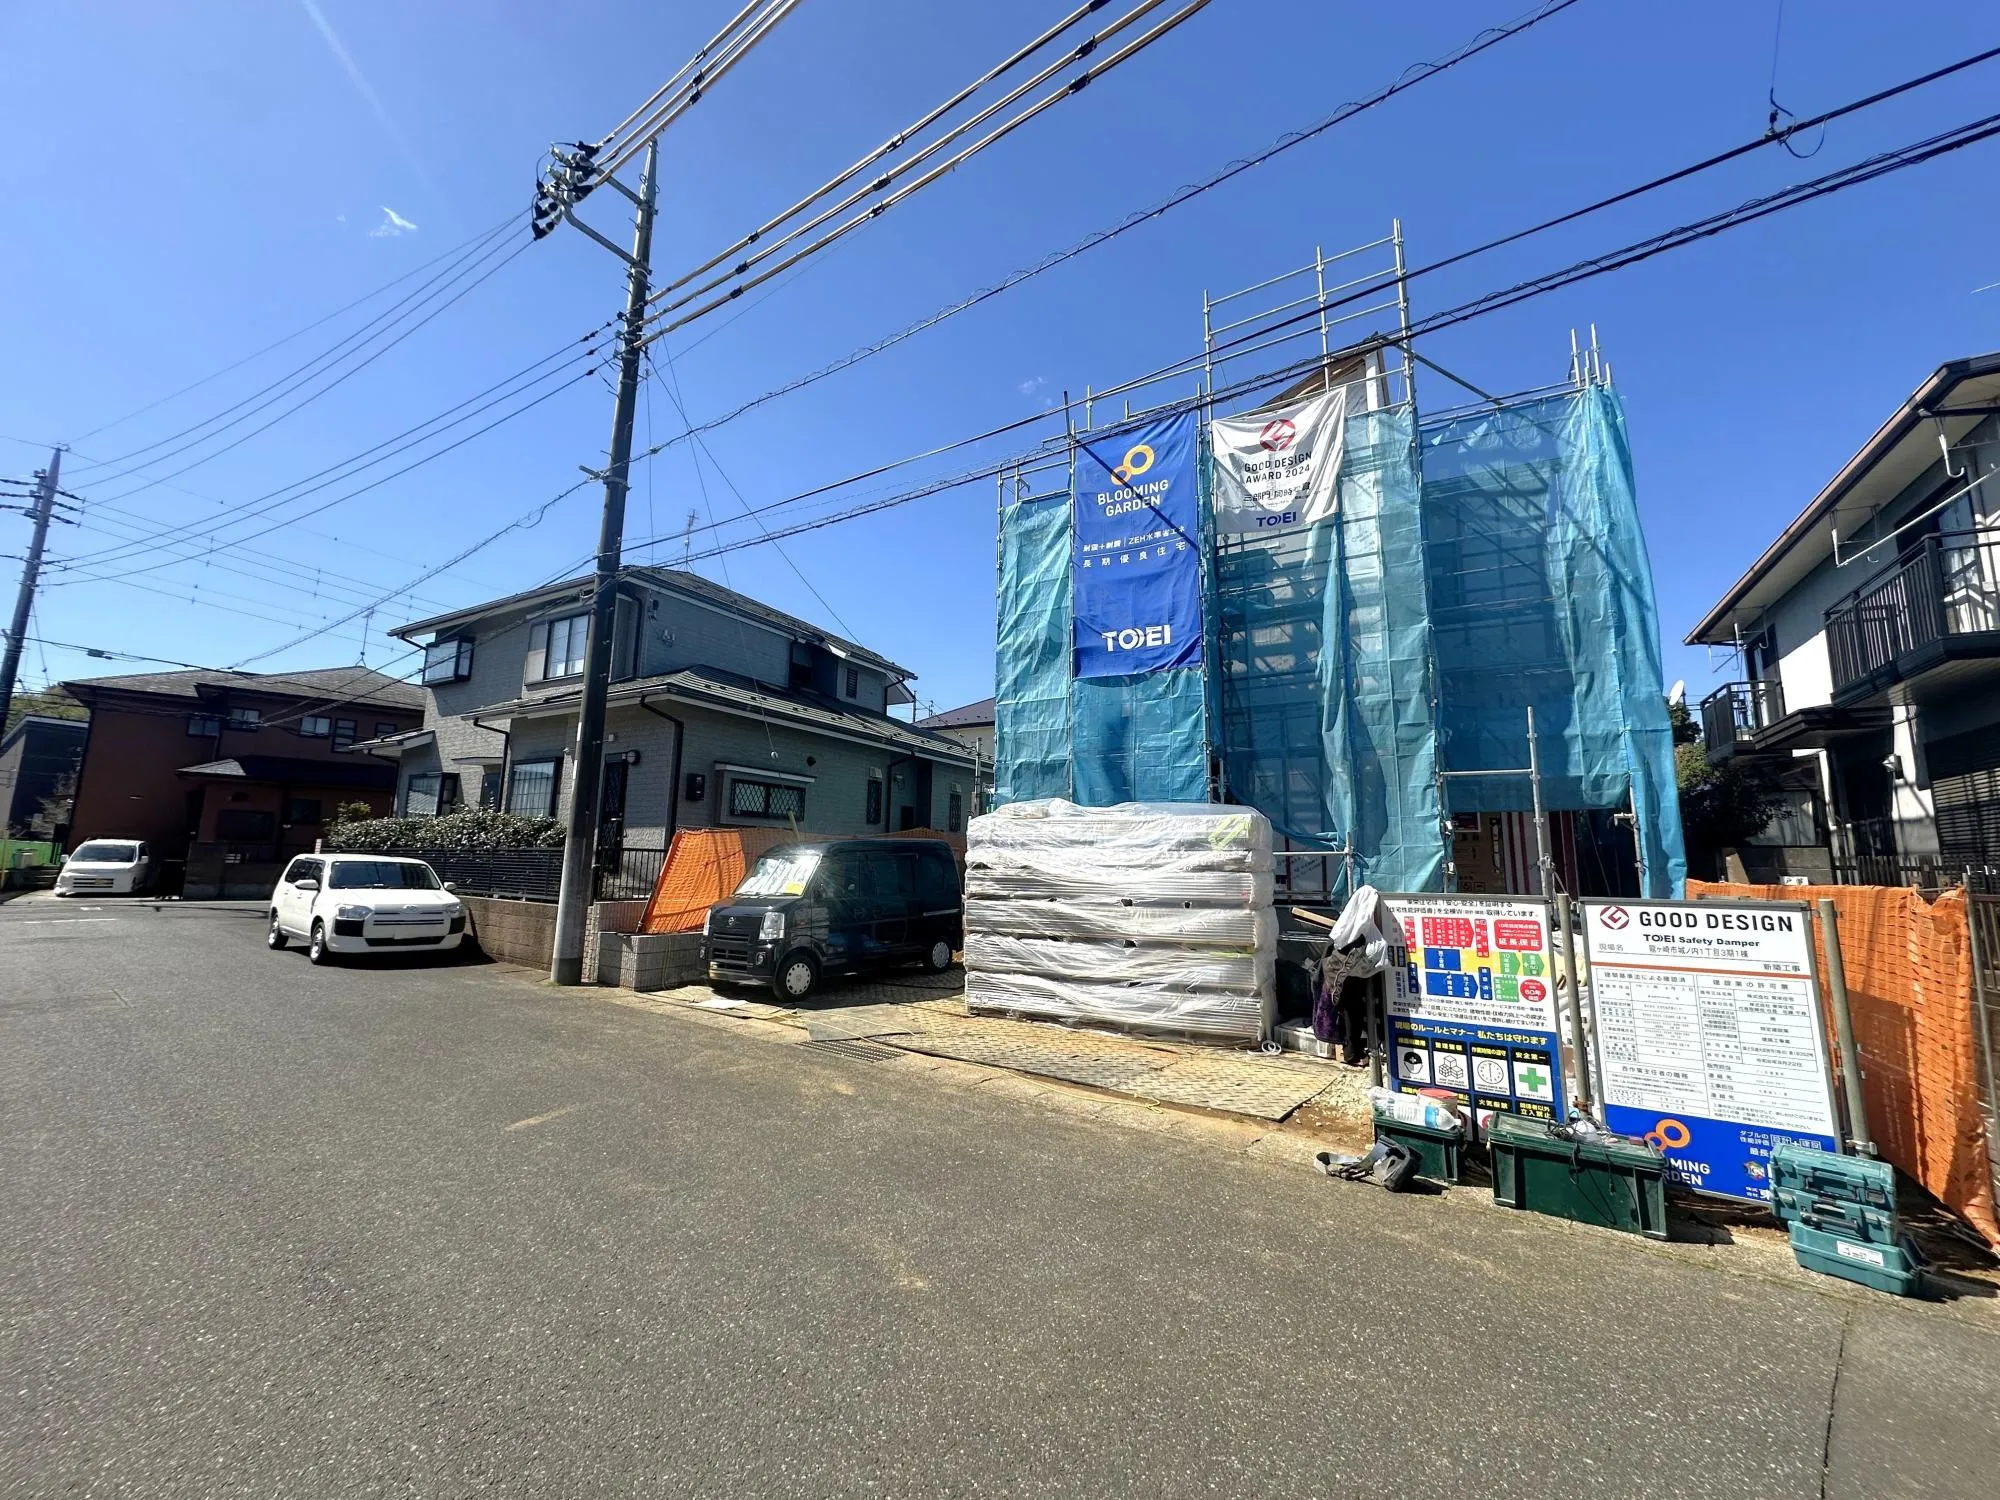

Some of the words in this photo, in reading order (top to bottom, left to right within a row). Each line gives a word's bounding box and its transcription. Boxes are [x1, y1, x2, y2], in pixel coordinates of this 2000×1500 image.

[1244, 459, 1271, 473] GOOD
[1274, 450, 1312, 468] DESIGN
[1245, 470, 1282, 484] AWARD
[1286, 464, 1310, 478] 2024
[1097, 479, 1169, 506] BLOOMING
[1106, 494, 1161, 517] GARDEN
[1256, 512, 1296, 527] TOEI
[1083, 541, 1186, 568] 長期優良住宅
[1102, 624, 1171, 651] TOEI
[1640, 911, 1698, 928] GOOD
[1706, 914, 1793, 932] DESIGN
[1643, 934, 1675, 943] TOEI
[1679, 937, 1714, 946] Safety
[1717, 938, 1760, 948] Damper
[1763, 963, 1801, 972] 新築工事
[1478, 1030, 1547, 1045] 私たちは守ります
[1515, 1051, 1546, 1060] 安全第一
[1740, 1130, 1769, 1139] ダブルの
